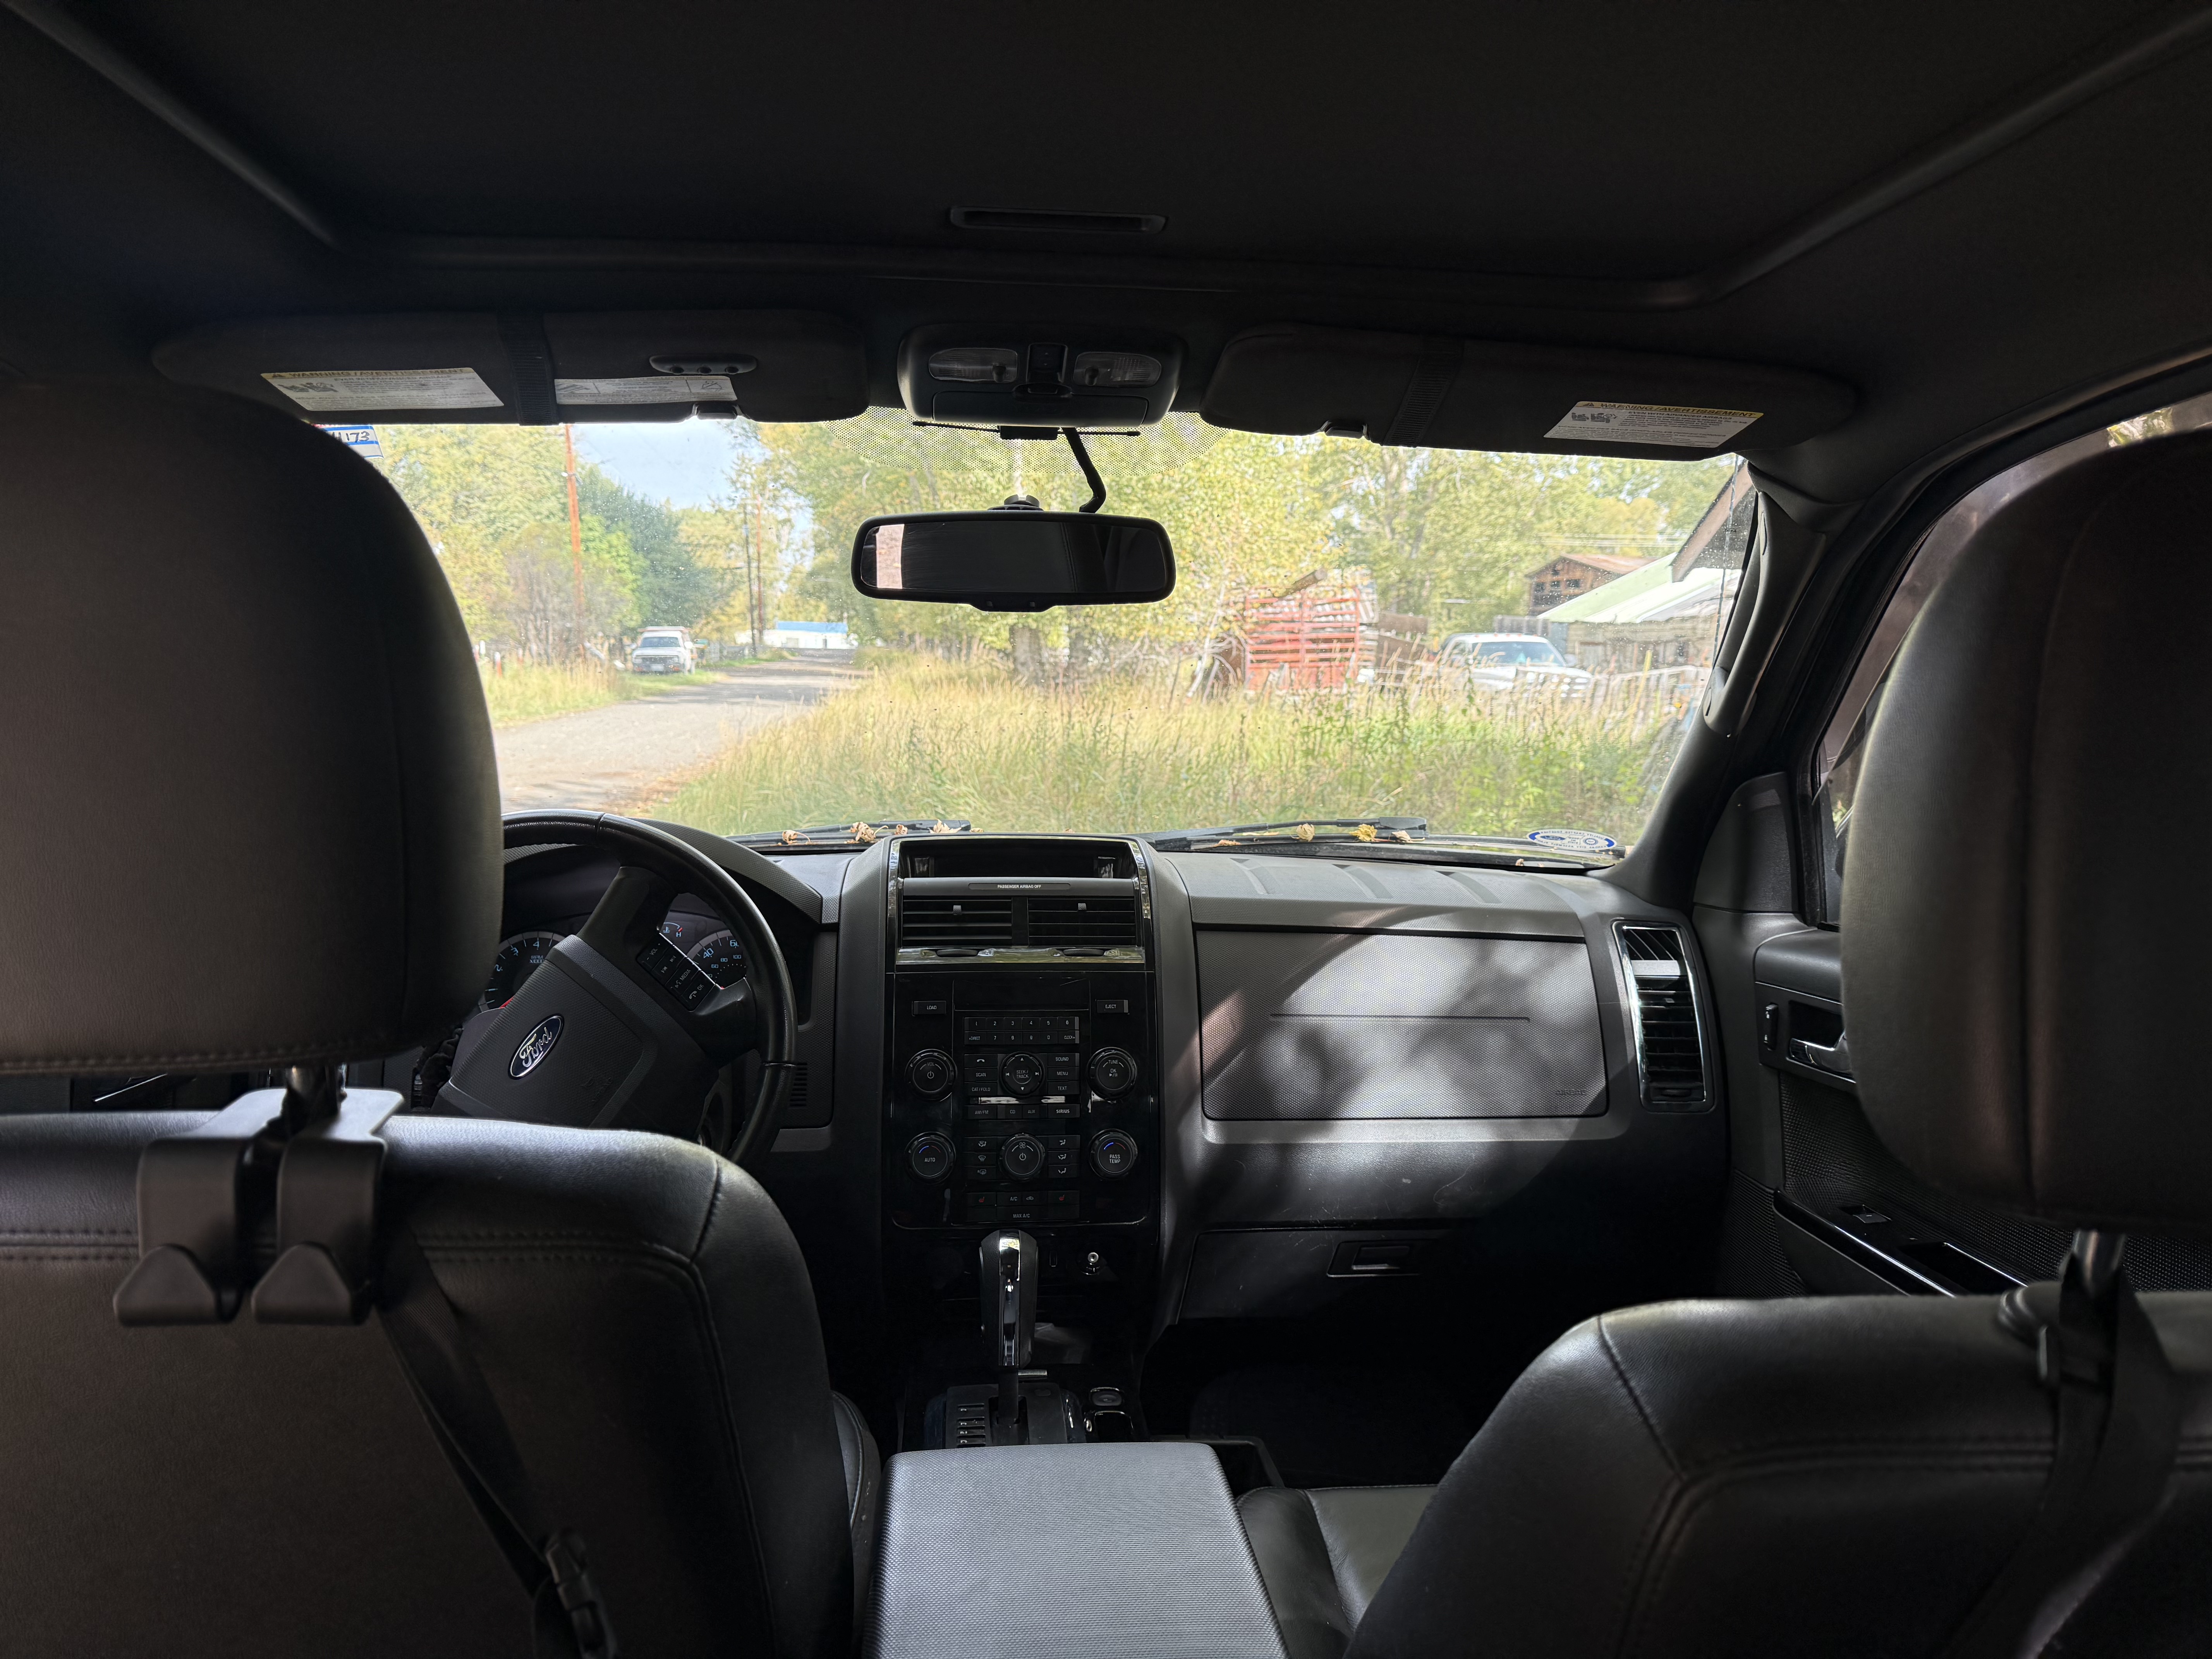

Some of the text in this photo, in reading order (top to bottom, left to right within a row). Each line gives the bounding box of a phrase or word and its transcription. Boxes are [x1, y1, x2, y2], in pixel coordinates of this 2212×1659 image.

[510, 947, 519, 955] 3
[703, 948, 714, 959] 40
[680, 969, 691, 981] MEDIA
[518, 1026, 553, 1069] Ford
